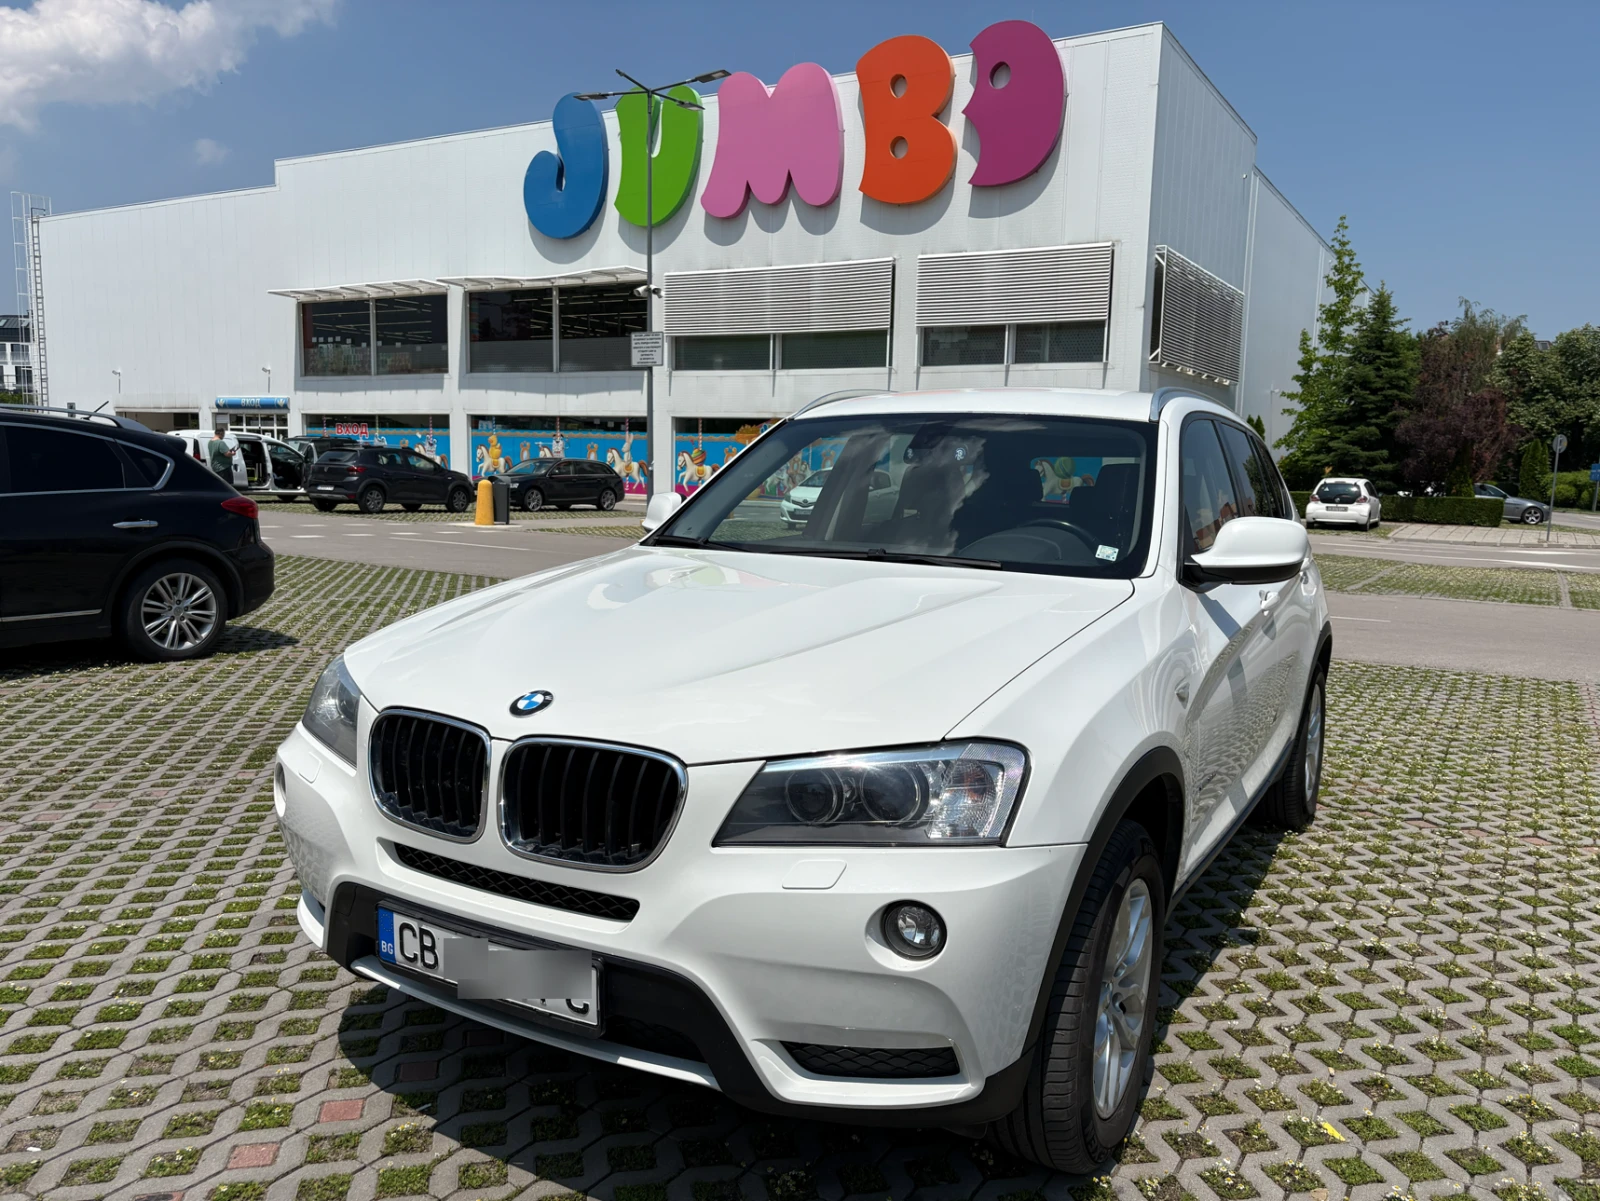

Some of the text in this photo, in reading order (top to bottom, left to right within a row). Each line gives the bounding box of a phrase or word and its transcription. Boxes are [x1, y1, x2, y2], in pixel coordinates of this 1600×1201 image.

[524, 20, 1066, 239] JUMBO
[241, 398, 261, 408] ВХОД
[335, 423, 369, 439] ВХОД
[381, 941, 394, 955] BG
